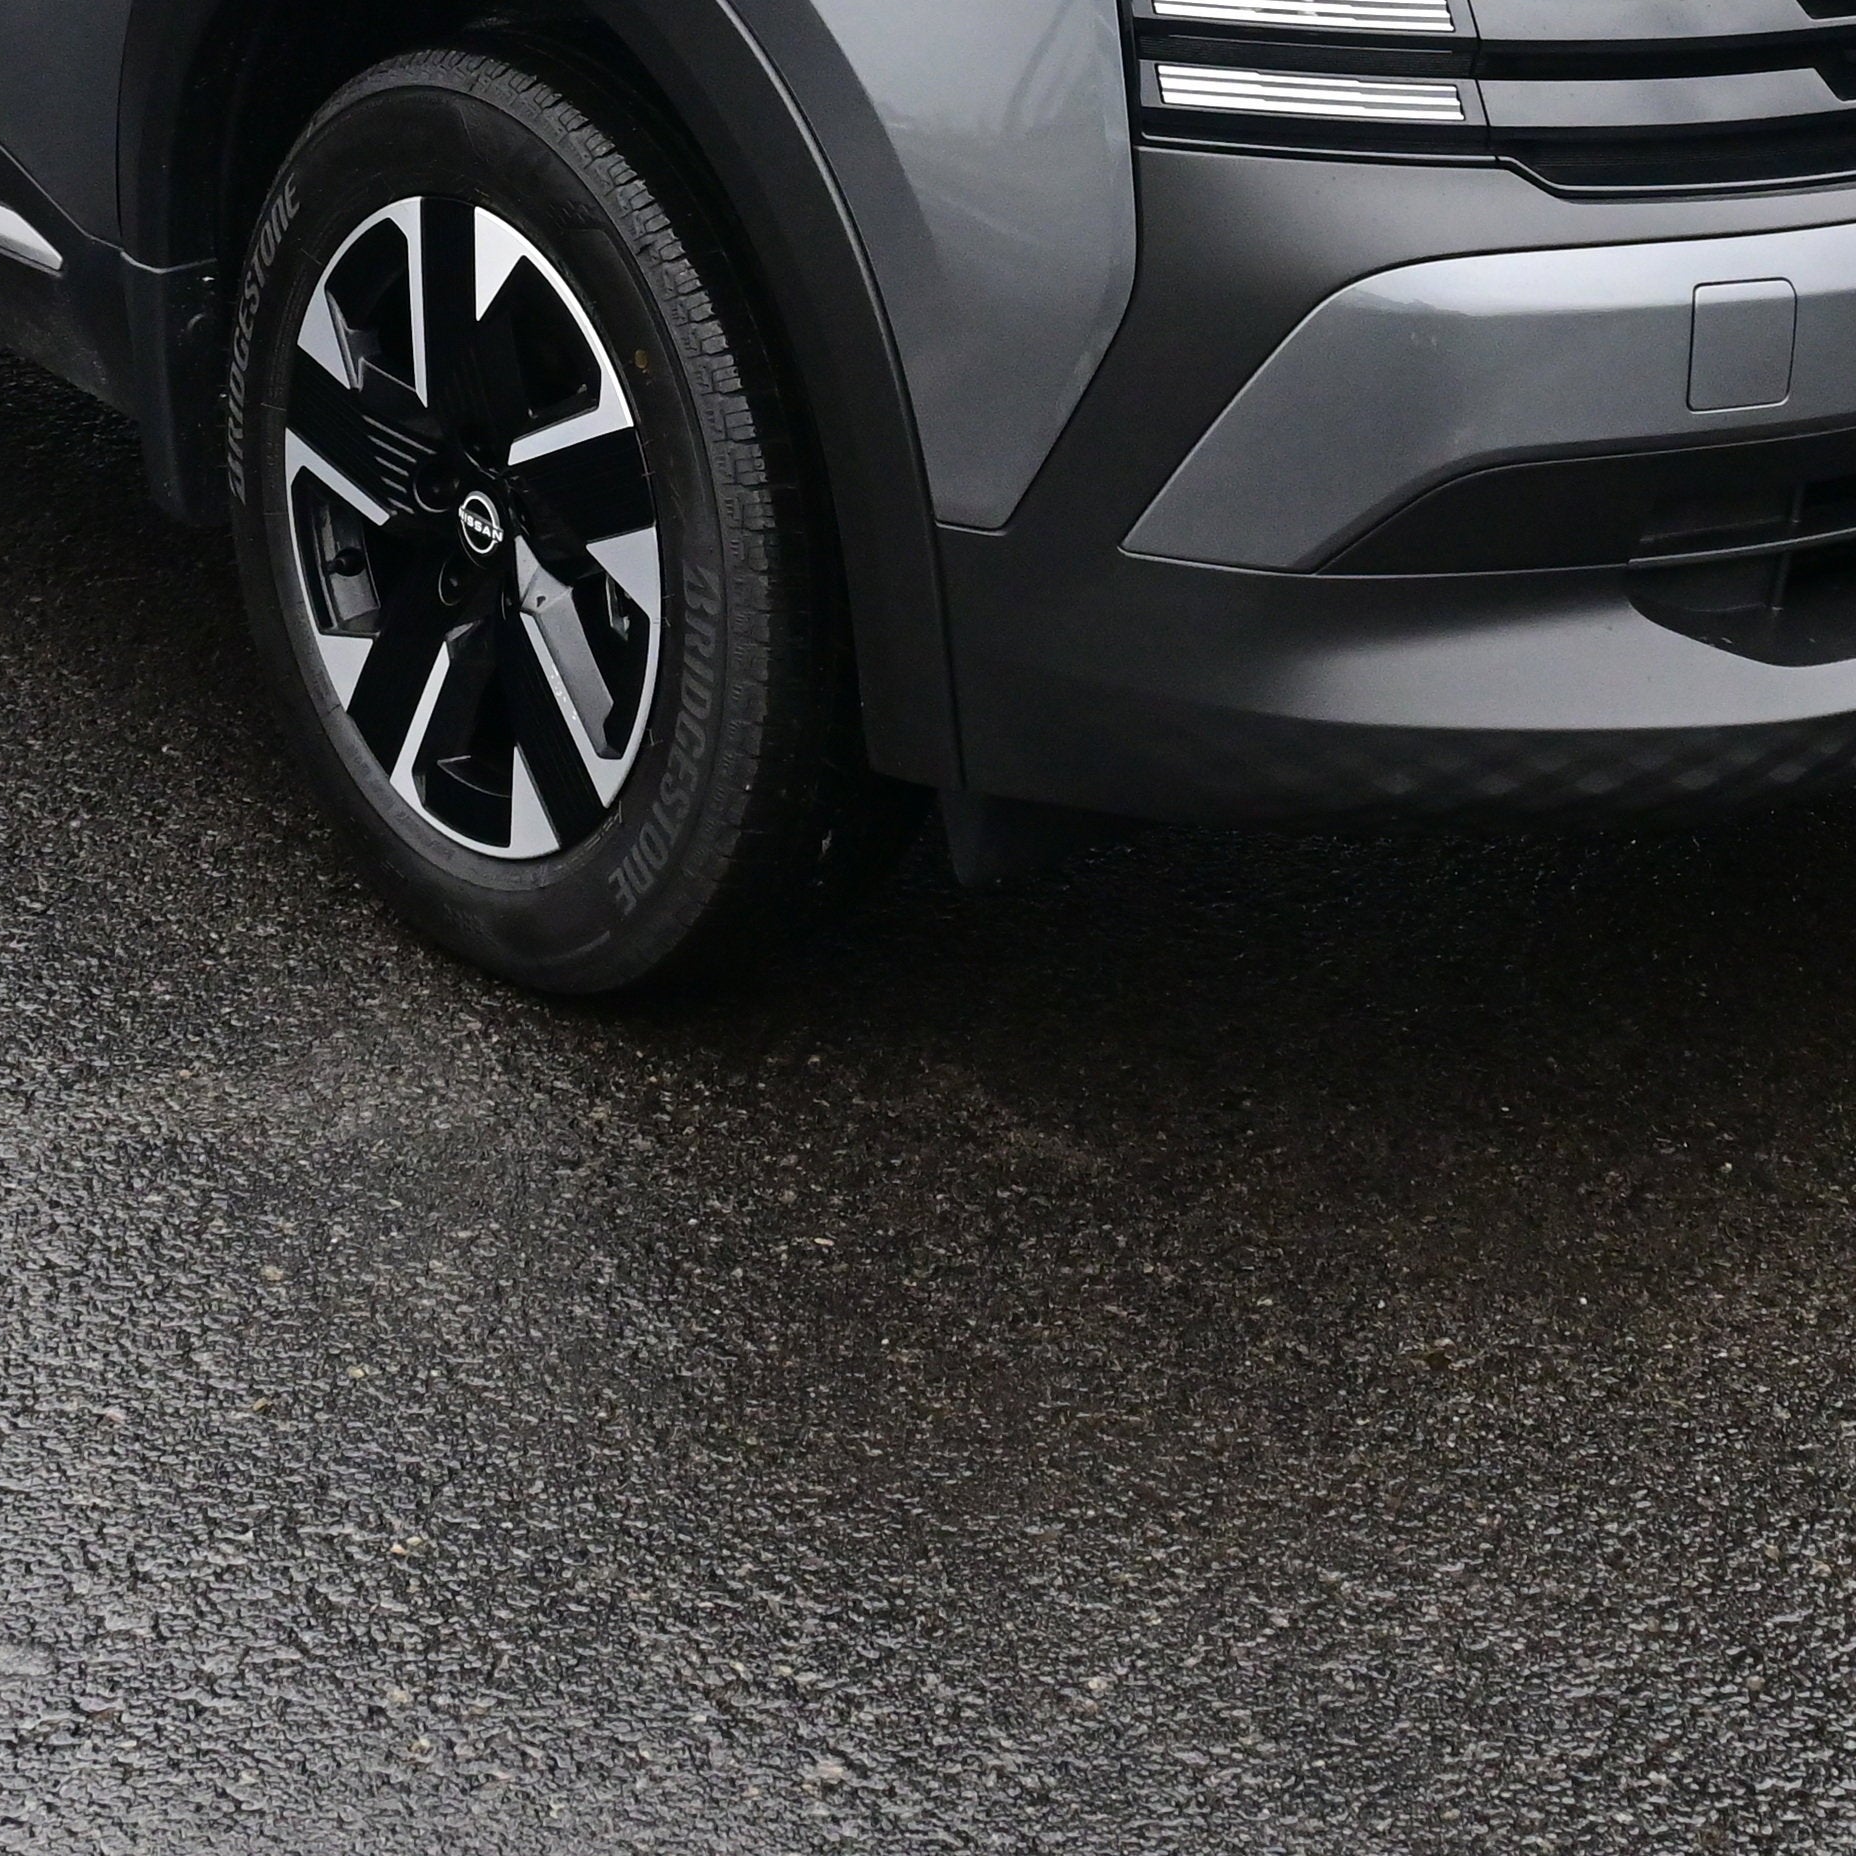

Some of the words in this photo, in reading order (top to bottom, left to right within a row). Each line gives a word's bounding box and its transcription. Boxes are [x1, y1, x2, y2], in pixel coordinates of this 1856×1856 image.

[228, 172, 300, 507] BRIDGESTONE
[458, 507, 504, 542] NISSAN
[608, 558, 723, 916] BRIDGESTONE
